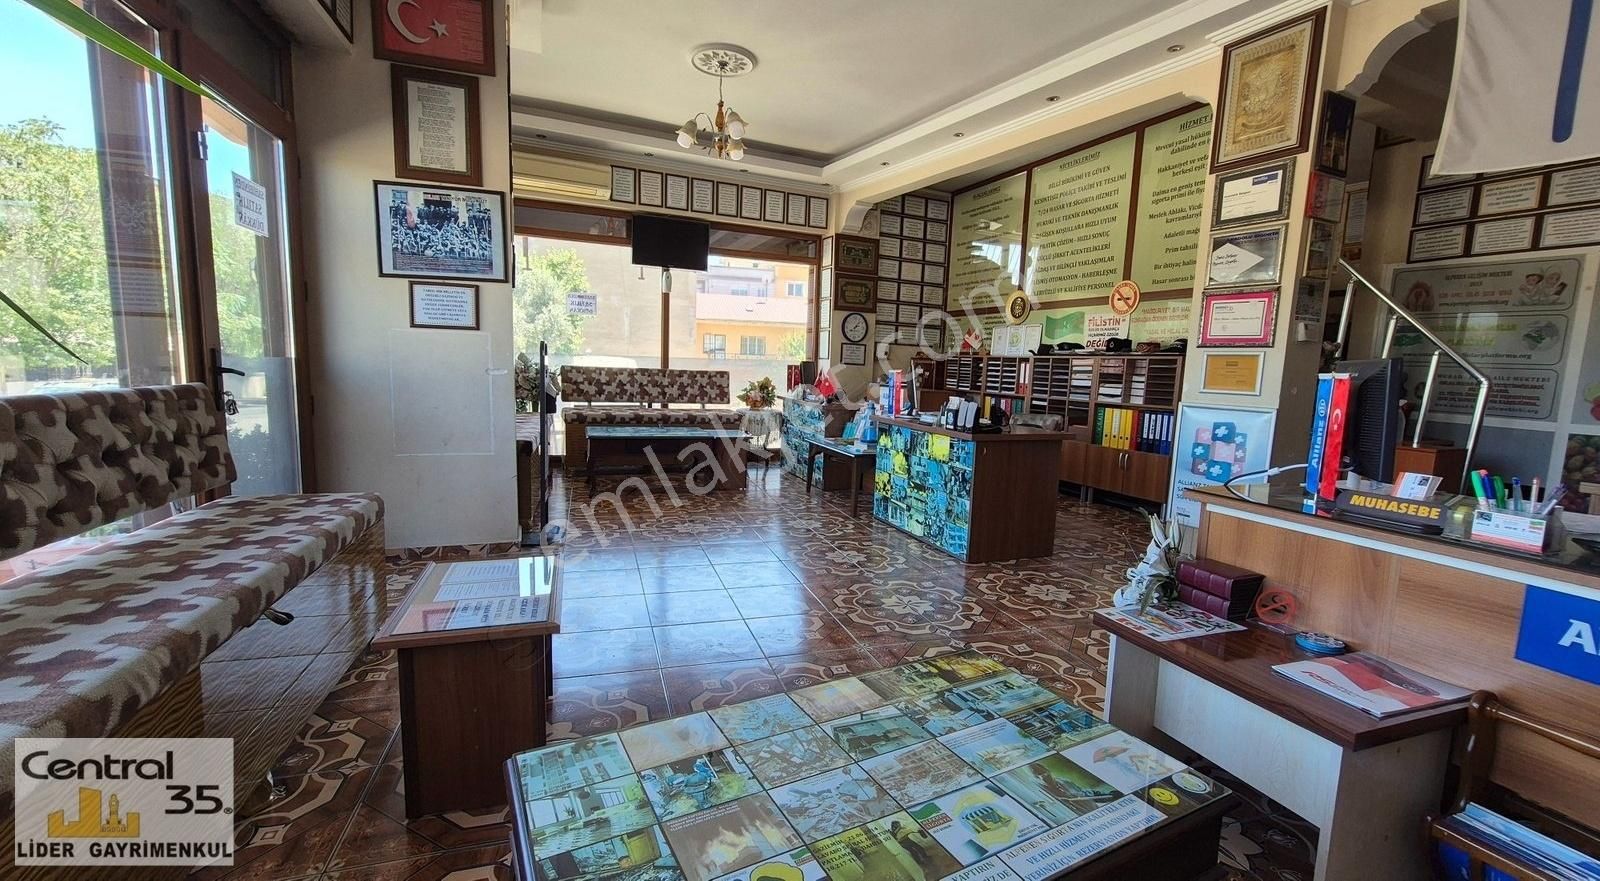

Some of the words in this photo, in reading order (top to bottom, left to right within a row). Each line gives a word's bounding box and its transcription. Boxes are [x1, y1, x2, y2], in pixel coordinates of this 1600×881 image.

[1179, 116, 1209, 131] HİZMET
[1170, 141, 1197, 154] dahilinde
[1175, 136, 1189, 146] yasal
[1091, 165, 1110, 175] GÜVEN
[1157, 160, 1188, 174] Hakkaniyet
[1172, 166, 1193, 177] herkesi
[1103, 173, 1126, 184] TESLİMİ
[1152, 188, 1169, 197] Daima
[1177, 181, 1193, 191] geniş
[1049, 204, 1065, 213] HASAR
[1071, 196, 1094, 207] SİGORTA
[1095, 189, 1119, 200] HİZMETİ
[1151, 195, 1170, 205] sigorta
[1170, 191, 1186, 200] primi
[1062, 212, 1080, 222] TEKNİK
[1081, 202, 1118, 216] DANIŞMANLIK
[1148, 210, 1166, 220] Meslek
[1055, 223, 1084, 235] KOŞULLARA
[1084, 219, 1099, 228] HIZLI
[1100, 215, 1116, 225] UYUM
[1039, 242, 1055, 251] PRATİK
[1056, 238, 1073, 247] ÇÖZÜM
[1091, 229, 1110, 239] SONUÇ
[1163, 230, 1184, 239] Adaletli
[1051, 250, 1069, 260] ŞİRKET
[1069, 242, 1110, 256] ACENTELİKLERİ
[1164, 246, 1178, 254] Prim
[1048, 265, 1056, 273] VE
[1056, 261, 1076, 271] BİLİNÇLİ
[1077, 253, 1114, 267] YAKLAŞIMLAR
[1153, 263, 1162, 271] Bir
[1163, 260, 1181, 269] ihtiyaç
[1048, 272, 1078, 285] OTOMASYON
[1081, 265, 1117, 278] HABERLEŞME
[1168, 274, 1188, 282] sonrası
[1063, 283, 1086, 294] KALİFİYE
[1087, 278, 1114, 289] PERSONEL
[1088, 316, 1121, 327] FİLİSTİN
[1086, 338, 1108, 348] DEĞİL
[1311, 420, 1325, 468] Allianz
[1350, 494, 1441, 520] MUHASEBE
[1557, 618, 1600, 656] A
[1026, 854, 1041, 866] VE
[1040, 844, 1061, 861] HIZLI
[1060, 830, 1092, 852] HİZMET
[1089, 808, 1142, 839] DÜNYASINDAKİ
[1024, 858, 1059, 881] YERİNİZ
[1058, 852, 1075, 868] İÇİN
[1075, 829, 1128, 861] REZERVASYON
[1127, 813, 1160, 838] YAPTIRIN
[999, 869, 1012, 880] DE
